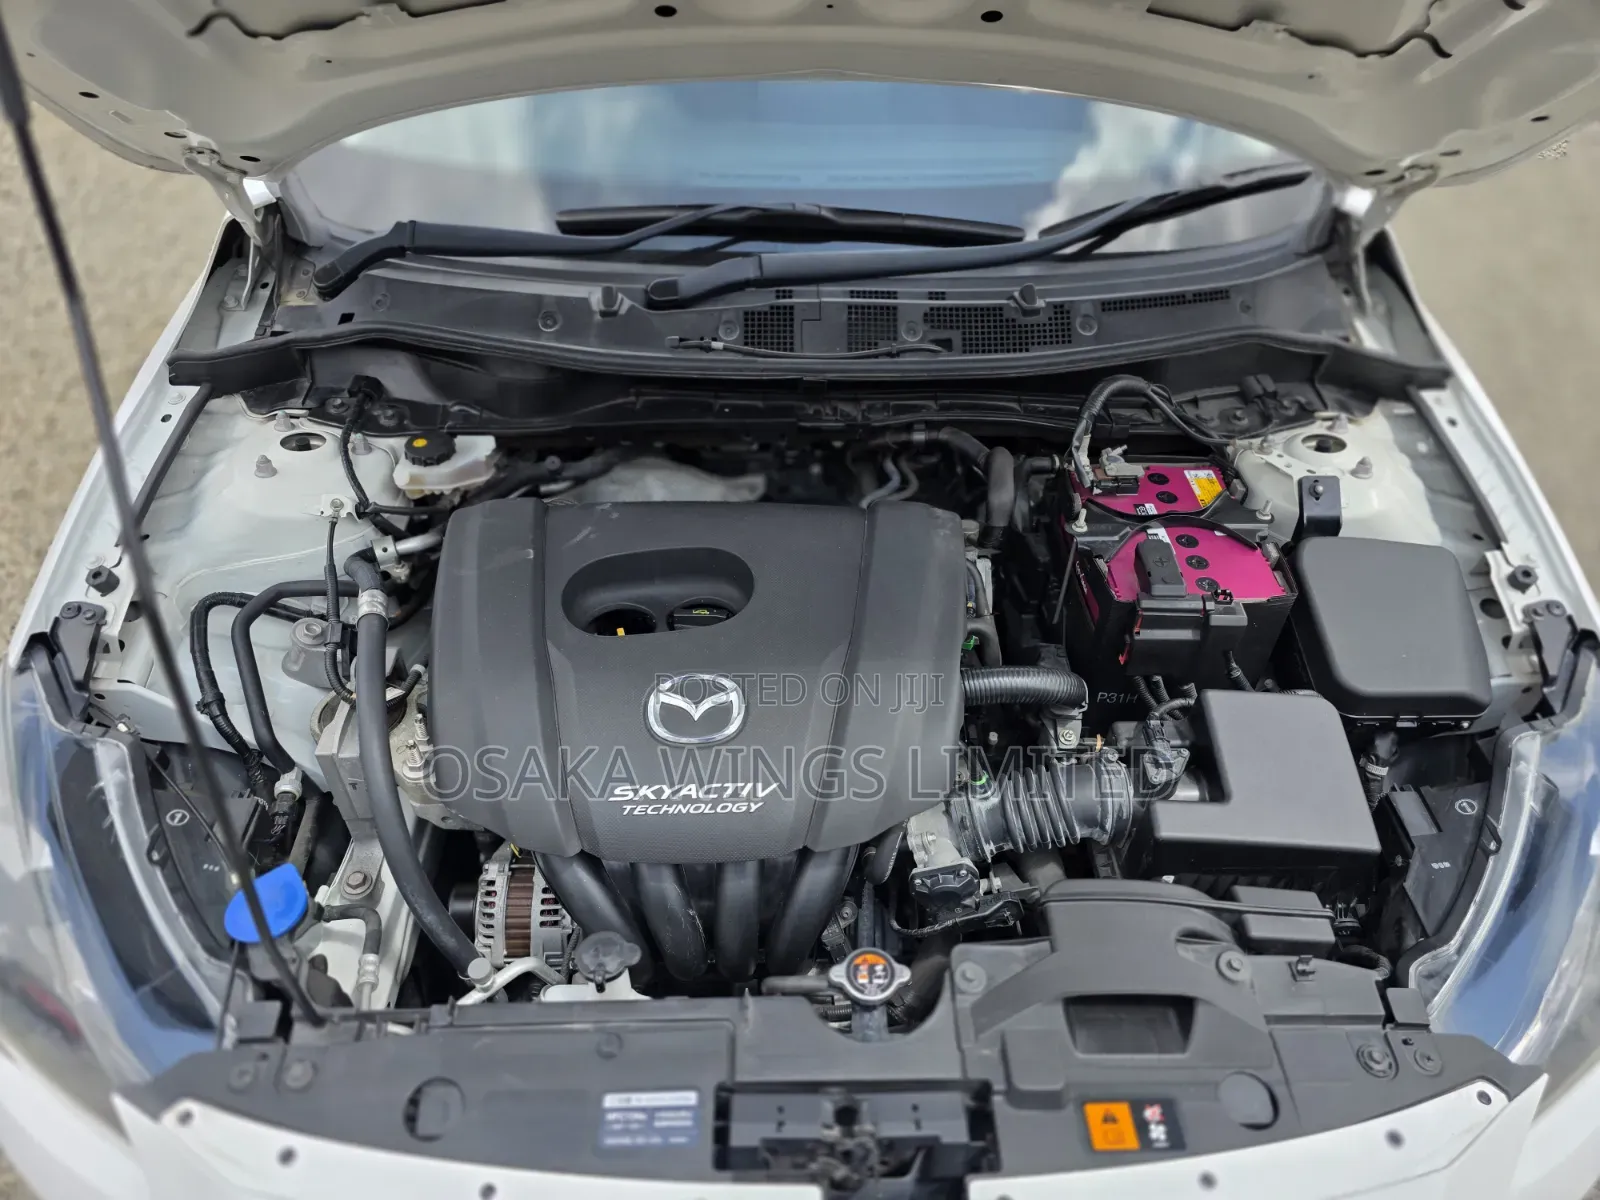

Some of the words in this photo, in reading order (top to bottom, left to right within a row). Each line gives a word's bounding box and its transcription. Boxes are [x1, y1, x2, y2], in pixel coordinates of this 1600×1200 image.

[1096, 691, 1138, 704] P31H
[608, 782, 779, 801] SKYACTIV
[622, 801, 764, 816] TECHNOLOGY
